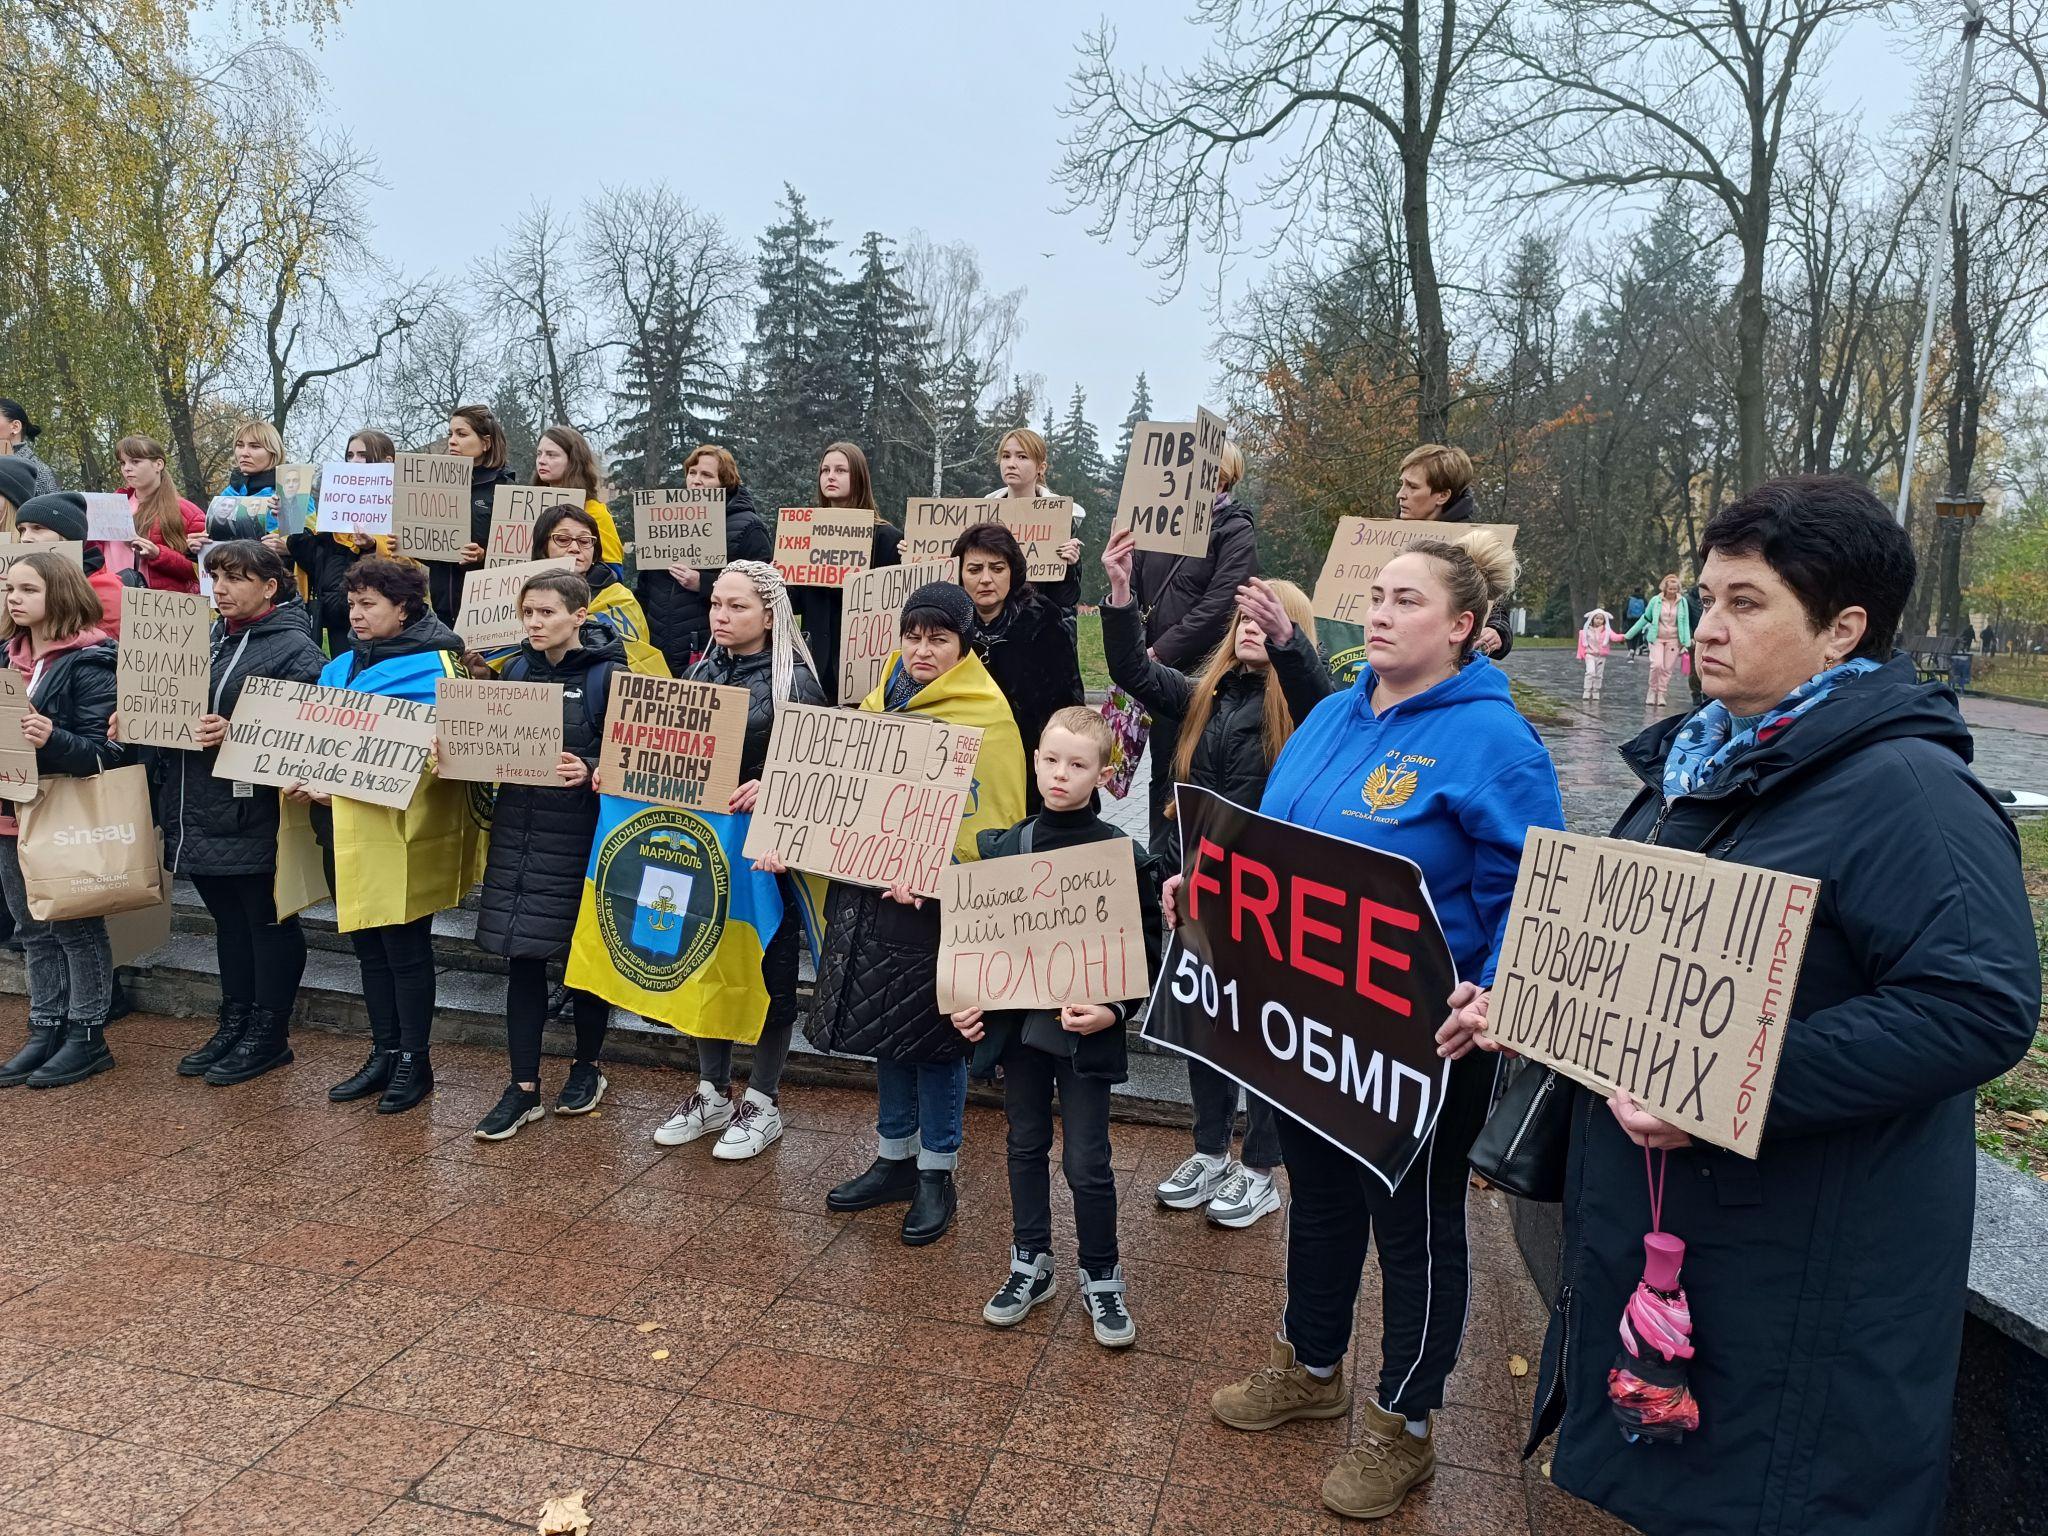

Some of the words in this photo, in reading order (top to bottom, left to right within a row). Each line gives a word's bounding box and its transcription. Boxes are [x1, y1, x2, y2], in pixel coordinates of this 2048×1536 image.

[333, 475, 392, 486] ПОВЕРНІТЬ
[404, 458, 425, 482] НЕ
[429, 460, 470, 486] МОВЧИ
[324, 492, 356, 504] МОГО
[360, 494, 393, 505] БАТЬК
[408, 492, 458, 518] ПОЛОН
[635, 490, 656, 506] НЕ
[666, 488, 724, 503] МОВЧИ
[1032, 499, 1047, 509] 107
[332, 512, 338, 520] З
[342, 512, 387, 523] ПОЛОНУ
[650, 506, 707, 521] ПОЛОН
[780, 510, 813, 521] ТВОЄ
[918, 504, 967, 526] ПОКИ
[975, 504, 999, 524] ТИ
[1130, 505, 1184, 536] МОЄ
[402, 526, 460, 552] ВБИВАЄ
[648, 522, 712, 539] ВБИВАЄ
[779, 535, 811, 550] ЇХНЯ
[812, 525, 873, 539] МОВЧАННЯ
[654, 544, 701, 562] brigade
[809, 549, 867, 566] СМЕРТЬ
[469, 578, 492, 604] НЕ
[848, 574, 874, 615] ДЕ
[128, 592, 196, 618] ЧЕКАЮ
[1333, 593, 1364, 622] НЕ
[133, 621, 194, 648] КОЖНУ
[846, 614, 893, 661] АЗОВ
[122, 649, 208, 677] ХВИЛИНУ
[140, 676, 178, 698] ЩОБ
[245, 676, 286, 698] ВЖЕ
[288, 681, 375, 711] ДРУГИЙ
[383, 697, 422, 721] РІК
[440, 683, 472, 699] ВОНИ
[479, 686, 549, 702] ВРЯТУВАЛИ
[124, 694, 200, 719] ОБІЙНЯТИ
[296, 702, 380, 732] ПОЛОНІ
[488, 704, 512, 716] НАС
[128, 719, 192, 743] СИНА
[440, 720, 484, 736] ТЕПЕР
[487, 723, 507, 739] МИ
[514, 727, 560, 741] МАЄМО
[225, 719, 261, 745] МІЙ
[261, 728, 305, 752] СИН
[305, 736, 352, 758] МОЄ
[351, 736, 432, 774] ЖИТТЯ
[449, 742, 520, 756] ВРЯТУВАТИ
[956, 735, 980, 752] FREE
[253, 754, 270, 774] 12
[277, 756, 347, 785] brigade
[619, 747, 631, 769] З
[637, 751, 711, 781] ПОЛОНУ
[953, 752, 975, 764] AZOV
[1402, 755, 1436, 768] ОБМП
[496, 764, 549, 778] #freeazov
[622, 771, 705, 805] ЖИВИМИ!
[763, 771, 868, 827] ПОЛОНУ
[881, 784, 958, 846] СИНА
[1341, 809, 1372, 821] МОРСЬКА
[1373, 816, 1399, 826] ПІХОТА
[53, 822, 136, 847] sinsay
[774, 822, 808, 862] ТА
[600, 812, 667, 866] НАЦІОНАЛЬНА
[670, 813, 712, 842] ГВАРДІЯ
[709, 840, 728, 896] УКРАЇНИ
[640, 844, 702, 869] МАРІУПОЛЬ
[71, 877, 94, 885] SHOP
[96, 873, 128, 883] ONLINE
[948, 872, 1028, 913] Майже
[1031, 860, 1056, 900] 2
[1060, 869, 1116, 905] роки
[605, 897, 611, 907] 12
[1524, 838, 1577, 914] НЕ
[1583, 855, 1715, 952] МОВЧИ
[606, 909, 623, 948] БРИГАДА
[1014, 905, 1087, 935] тато
[1190, 836, 1420, 1017] FREE
[1513, 916, 1630, 1002] ГОВОРИ
[1646, 953, 1735, 1039] ПРО
[1171, 948, 1240, 1032] 501
[1261, 1000, 1430, 1139] ОБМП
[1494, 972, 1718, 1122] ПОЛОНЕНИХ
